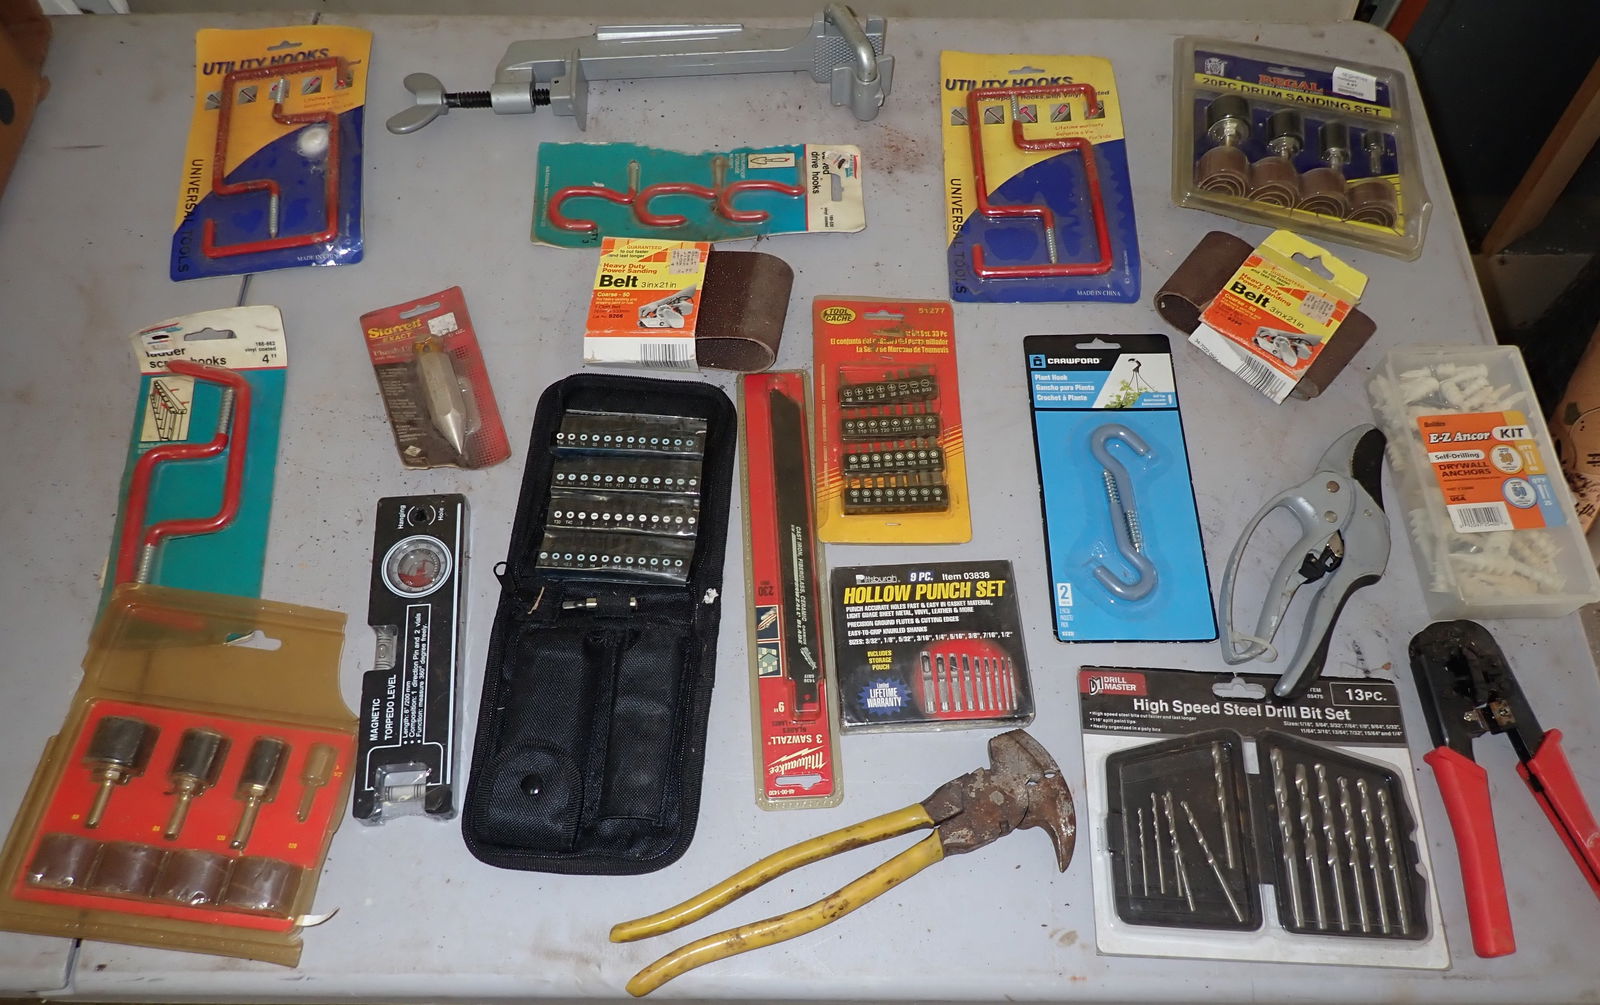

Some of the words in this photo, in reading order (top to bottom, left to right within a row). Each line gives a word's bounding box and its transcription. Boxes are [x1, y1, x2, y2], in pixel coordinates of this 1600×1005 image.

[203, 58, 268, 76] UTILITY
[270, 48, 330, 68] HOOKS
[945, 79, 1008, 91] UTILITY
[1012, 76, 1073, 88] HOOKS
[1258, 74, 1324, 93] REGAL
[1202, 78, 1237, 89] 20PC
[1240, 84, 1283, 99] DRUM
[1286, 92, 1351, 111] SANDING
[1354, 105, 1382, 116] SET
[811, 151, 820, 169] drive
[183, 159, 204, 228] UNIVERSAL
[811, 172, 820, 194] hooks
[950, 178, 964, 248] UNIVERSAL
[178, 231, 192, 273] TOOLS
[599, 274, 638, 288] Belt
[953, 252, 967, 294] TOOLS
[1230, 281, 1270, 308] Belt
[1239, 277, 1260, 290] Power
[1262, 288, 1292, 307] Sanding
[1241, 273, 1264, 287] Heavy
[1265, 285, 1281, 295] Duty
[1225, 294, 1244, 306] Coarse
[1429, 433, 1452, 443] E-Z
[1453, 432, 1490, 442] Ancor
[1500, 428, 1524, 438] KIT
[1435, 452, 1480, 460] Self-Drilling
[1438, 462, 1489, 470] DRYWALL
[1442, 468, 1492, 477] ANCHORS
[397, 504, 406, 530] Hanging
[910, 572, 917, 582] 9
[918, 572, 934, 581] PC.
[942, 573, 962, 581] Item
[963, 572, 990, 580] 03838
[758, 585, 774, 597] 230
[844, 584, 912, 604] HOLLOW
[915, 581, 971, 600] PUNCH
[976, 580, 1006, 597] SET
[1060, 585, 1069, 600] 2
[848, 629, 882, 637] EASY-TO-GRIP
[419, 643, 427, 664] degree
[387, 674, 397, 699] LEVEL
[406, 680, 411, 692] mm
[869, 689, 898, 698] LIFETIME
[774, 701, 785, 713] 9"
[867, 697, 902, 708] WARRANTY
[1133, 698, 1169, 715] High
[1172, 700, 1221, 717] Speed
[1223, 702, 1262, 717] Steel
[1265, 705, 1297, 719] Drill
[1300, 706, 1322, 720] Bit
[1325, 707, 1351, 721] Set
[369, 698, 380, 741] MAGNETIC
[384, 700, 395, 740] TORPEDO
[409, 695, 417, 738] Composition:
[416, 708, 424, 738] Function:
[770, 734, 812, 744] SAWZALL
[816, 734, 822, 743] 3
[768, 751, 828, 775] Milwaukee
